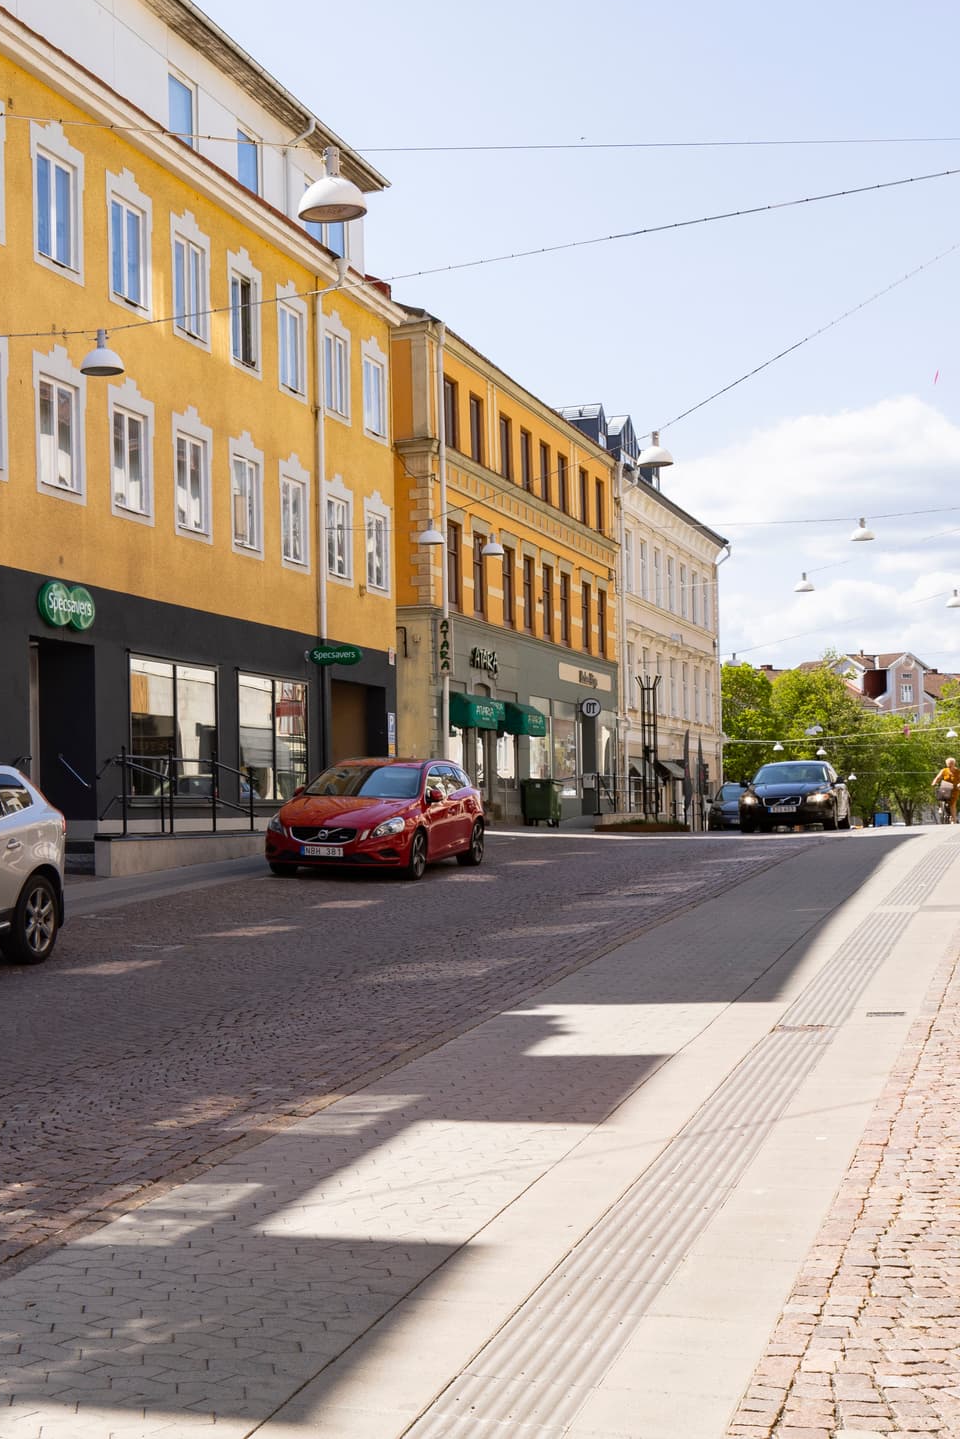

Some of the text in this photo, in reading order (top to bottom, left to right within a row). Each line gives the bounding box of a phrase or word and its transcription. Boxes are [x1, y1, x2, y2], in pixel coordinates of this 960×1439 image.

[48, 592, 92, 616] Specsavers
[439, 620, 451, 670] ATARA
[313, 650, 356, 660] Specsavers
[471, 646, 498, 673] ATARA
[586, 702, 597, 714] OT
[326, 847, 341, 856] 381
